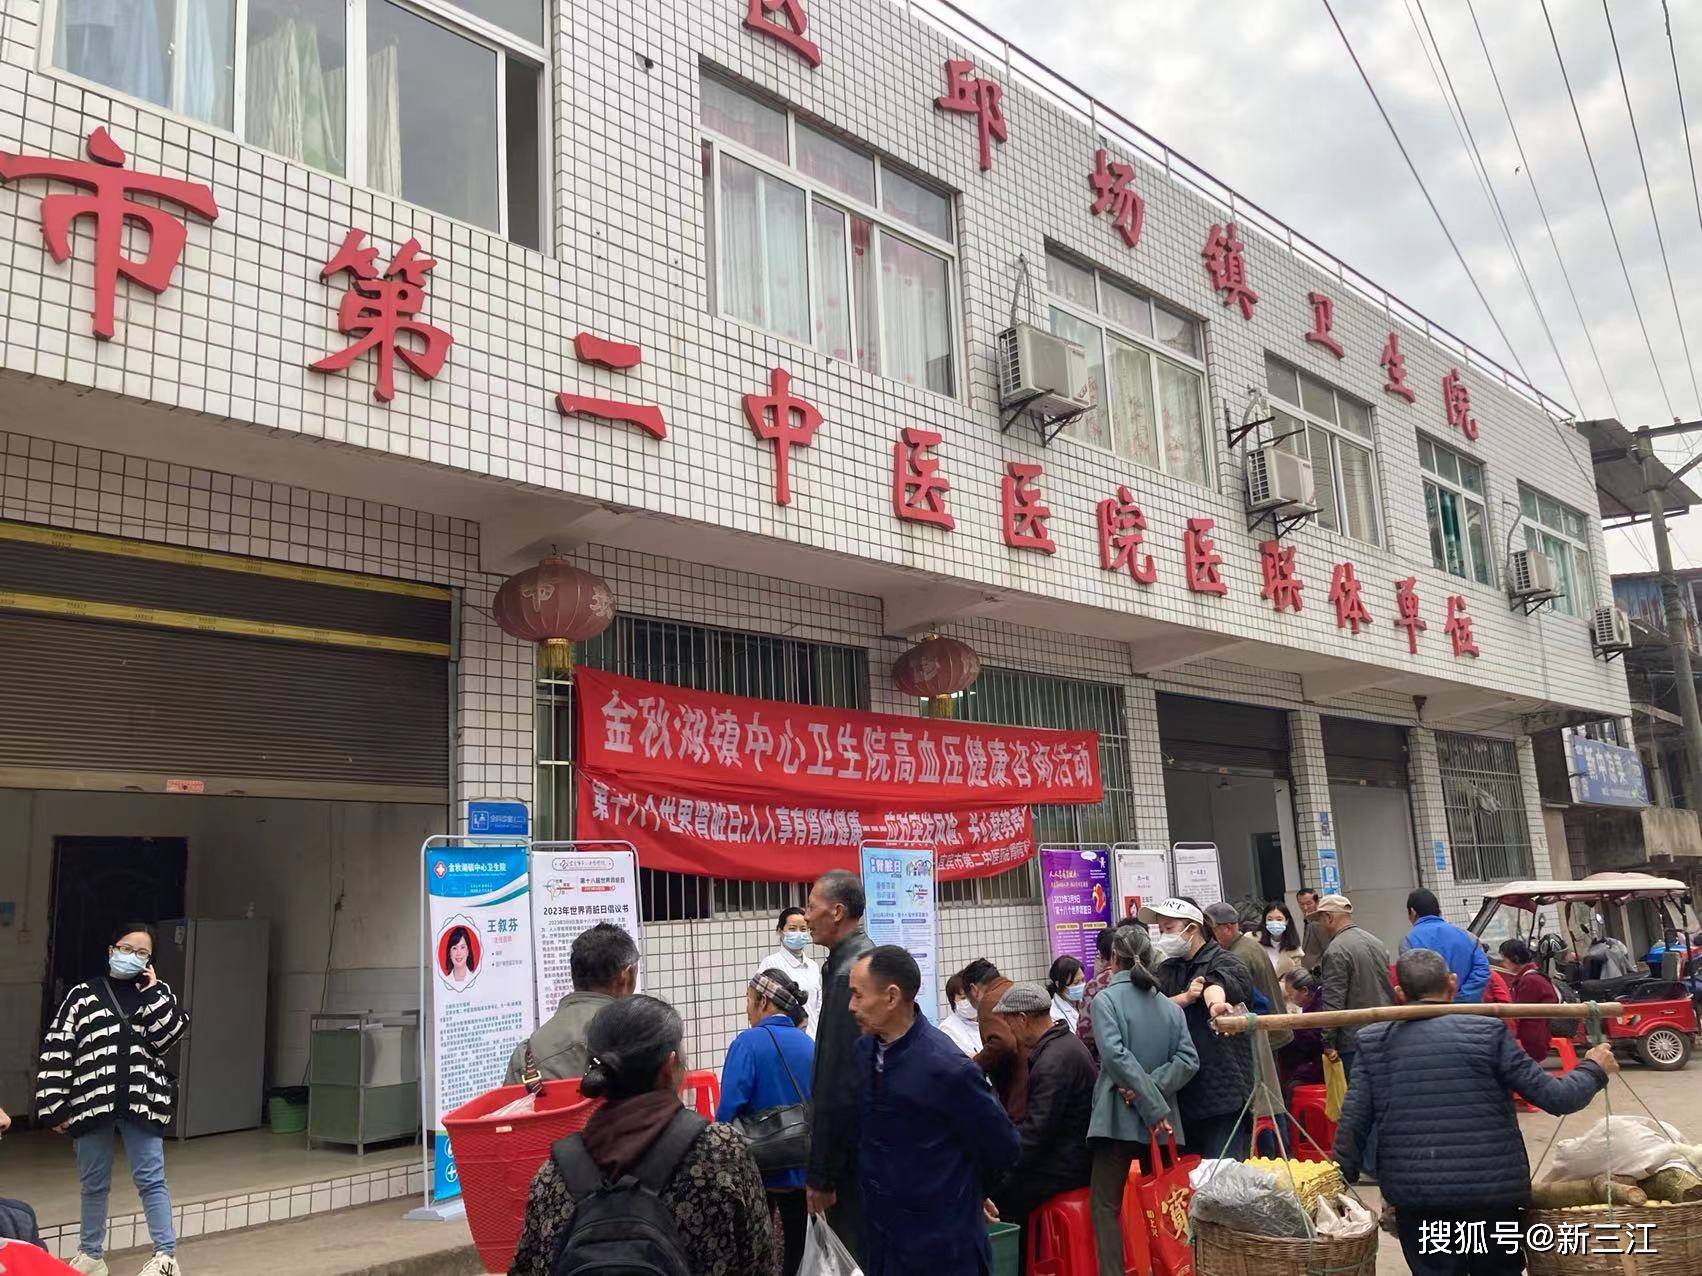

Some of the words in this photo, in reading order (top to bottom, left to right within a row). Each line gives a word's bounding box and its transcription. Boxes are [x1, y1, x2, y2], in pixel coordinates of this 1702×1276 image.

[0, 126, 1480, 657] 市第二中医医院医联体单位
[601, 688, 1094, 789] 金秋湖镇中心卫生院高血压健康咨询活动
[543, 904, 629, 916] 2023年世界肾脏日倡议书
